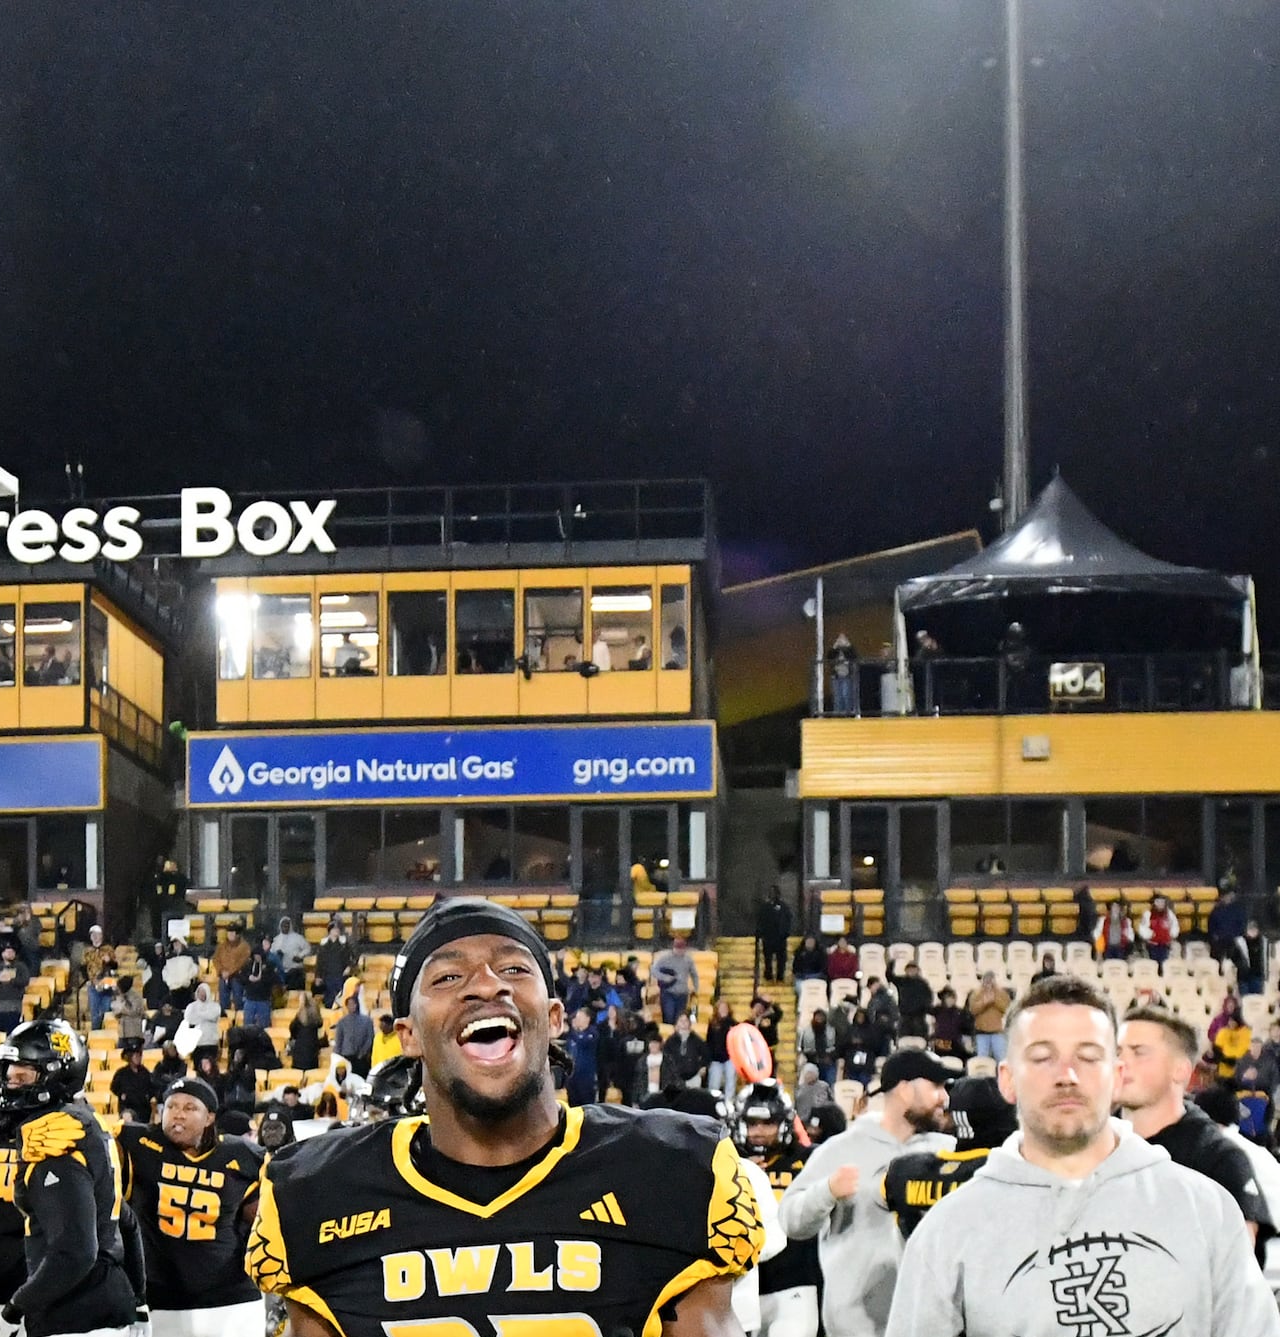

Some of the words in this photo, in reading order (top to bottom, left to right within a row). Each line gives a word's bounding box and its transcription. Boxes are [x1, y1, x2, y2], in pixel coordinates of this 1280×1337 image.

[180, 486, 337, 558] Box
[1050, 666, 1103, 693] 104
[248, 759, 351, 789] Georgia
[356, 756, 457, 782] Natural
[573, 756, 695, 785] gng.com
[161, 1162, 225, 1188] OWLS
[157, 1182, 221, 1241] 52
[381, 1239, 602, 1303] OWLS
